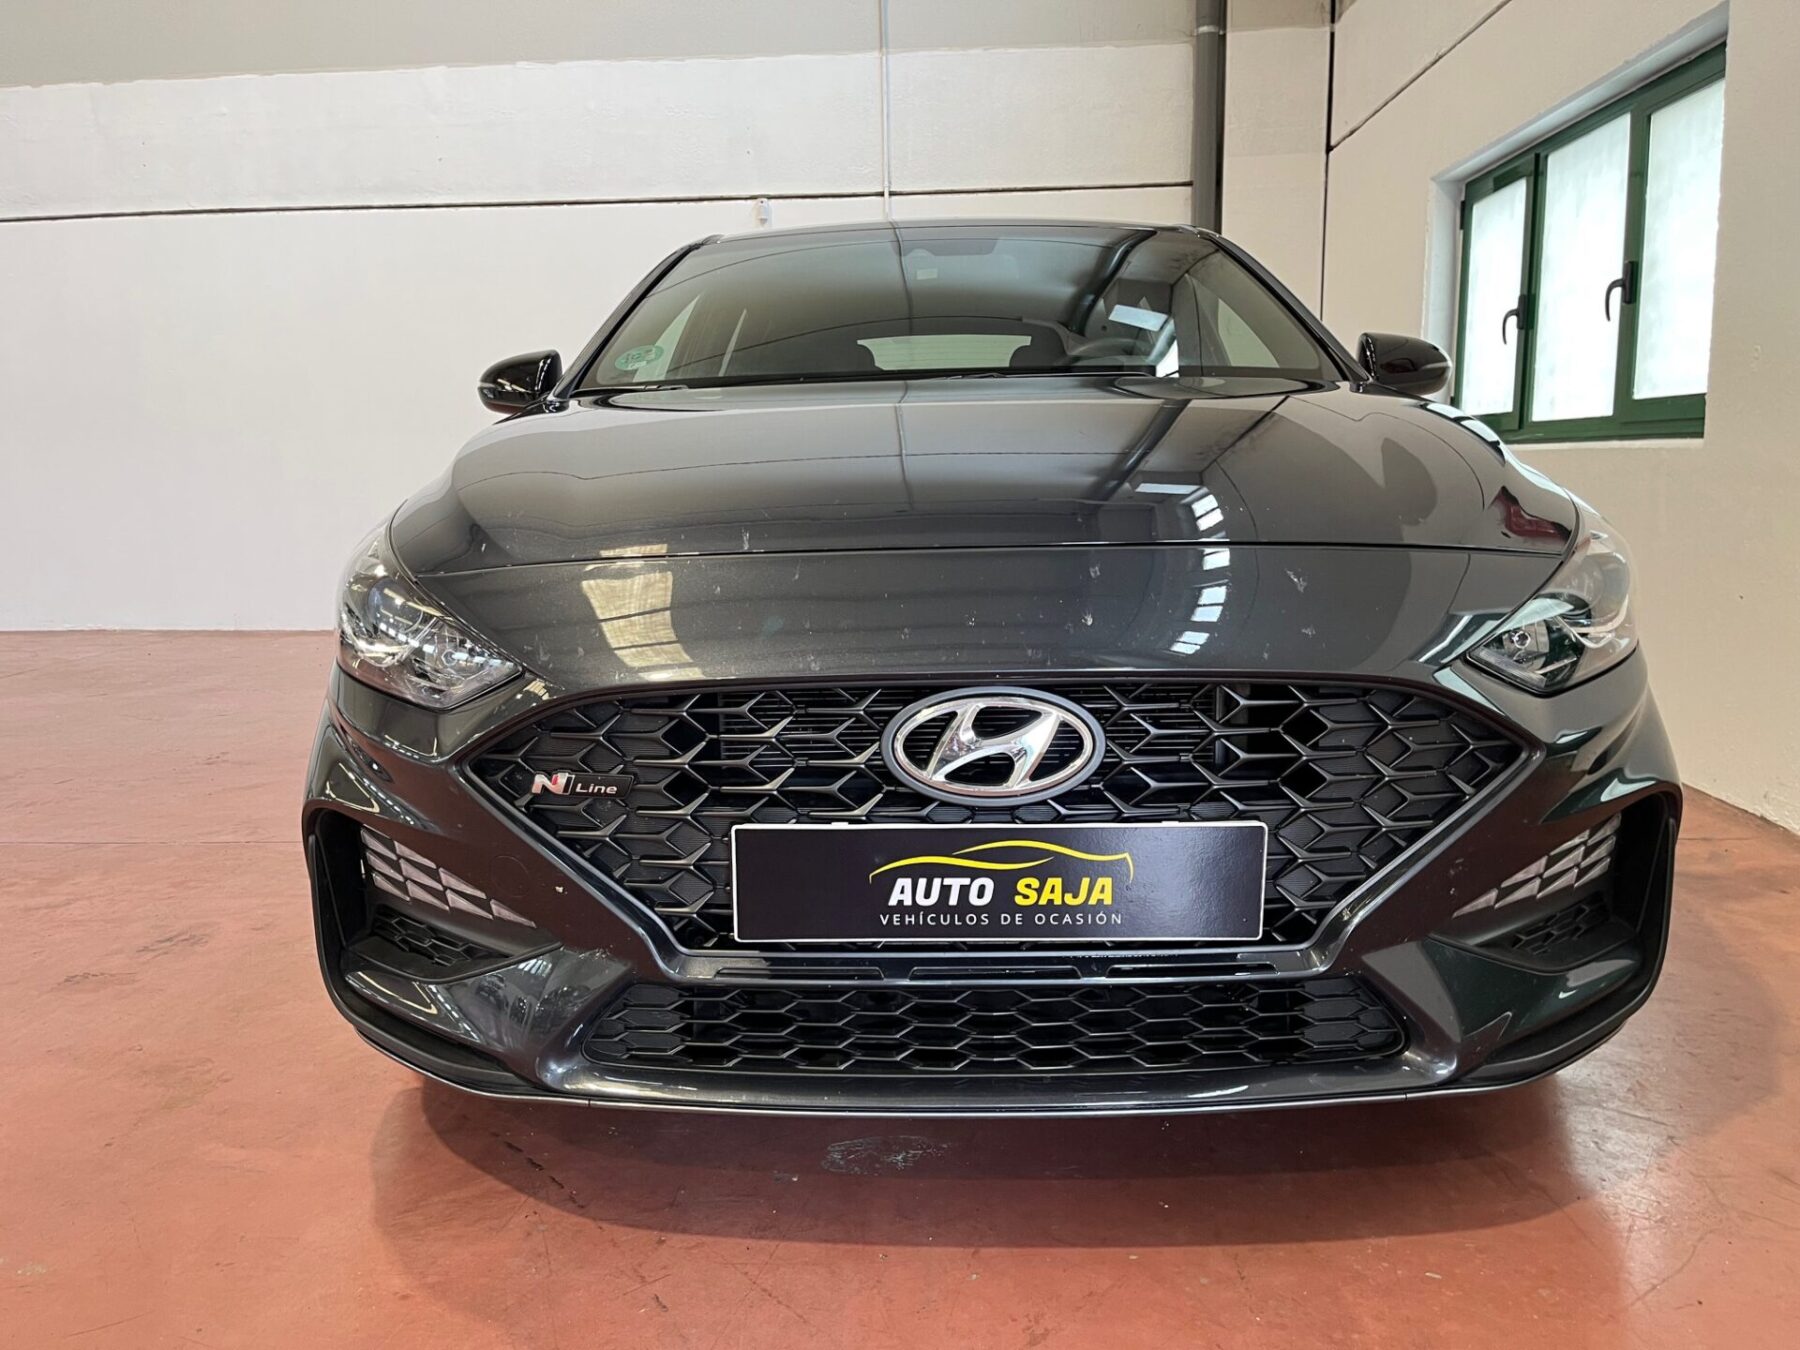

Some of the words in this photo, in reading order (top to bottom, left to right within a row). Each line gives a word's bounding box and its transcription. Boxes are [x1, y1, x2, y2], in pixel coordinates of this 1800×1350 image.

[531, 772, 569, 795] N
[575, 783, 618, 795] Line
[887, 877, 995, 907] AUTO
[1013, 877, 1114, 907] SAJA
[880, 911, 990, 926] VEHÍCULOS
[1000, 913, 1023, 925] DE
[1034, 911, 1122, 926] OCASIÓN
